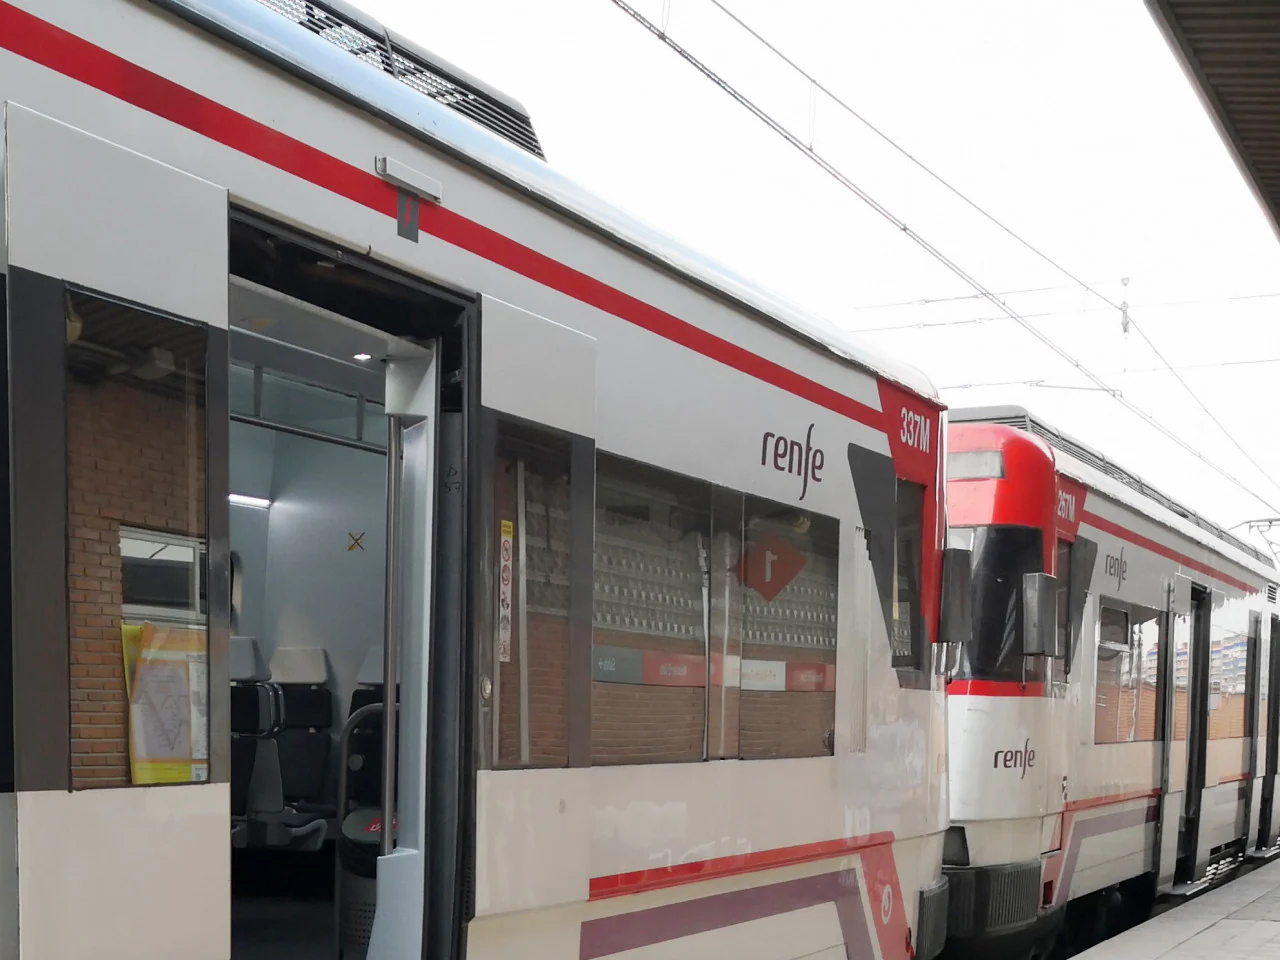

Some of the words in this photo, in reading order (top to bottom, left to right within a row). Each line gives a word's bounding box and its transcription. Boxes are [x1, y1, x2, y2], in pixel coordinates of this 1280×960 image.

[900, 407, 931, 454] 337M
[761, 423, 825, 501] renfe
[1057, 490, 1076, 523] 267M
[1104, 546, 1128, 592] renfe
[993, 737, 1035, 780] renfe
